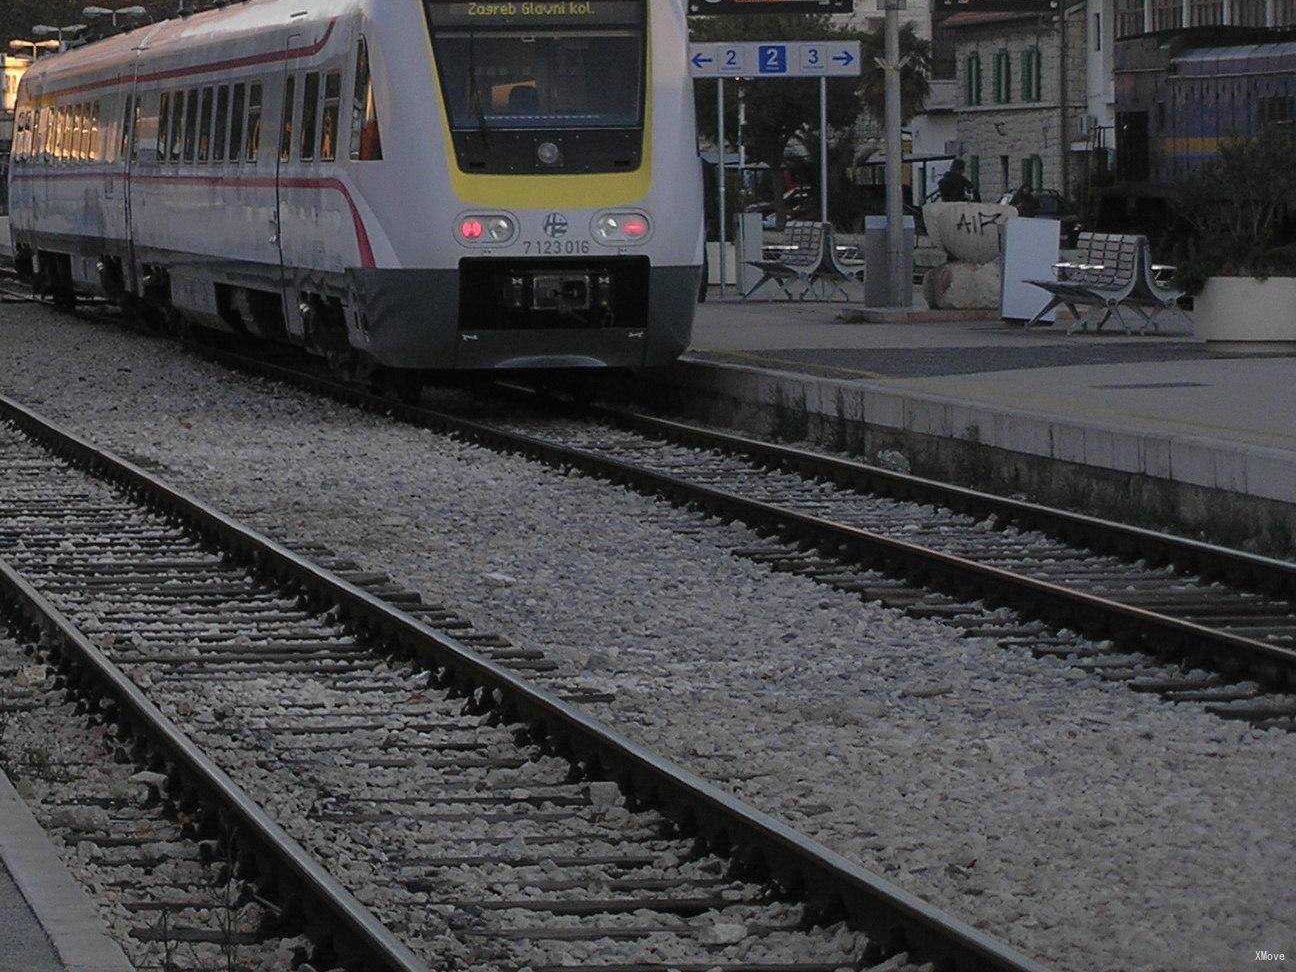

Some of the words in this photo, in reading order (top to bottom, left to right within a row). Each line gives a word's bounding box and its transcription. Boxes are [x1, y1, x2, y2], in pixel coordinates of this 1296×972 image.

[468, 2, 517, 16] Zagreb
[522, 1, 565, 15] Glavni
[569, 1, 596, 15] kol.
[726, 50, 736, 65] 2
[766, 48, 779, 66] 2
[808, 49, 819, 64] 3
[523, 241, 532, 254] 7
[536, 241, 562, 254] 123
[565, 241, 590, 254] 016
